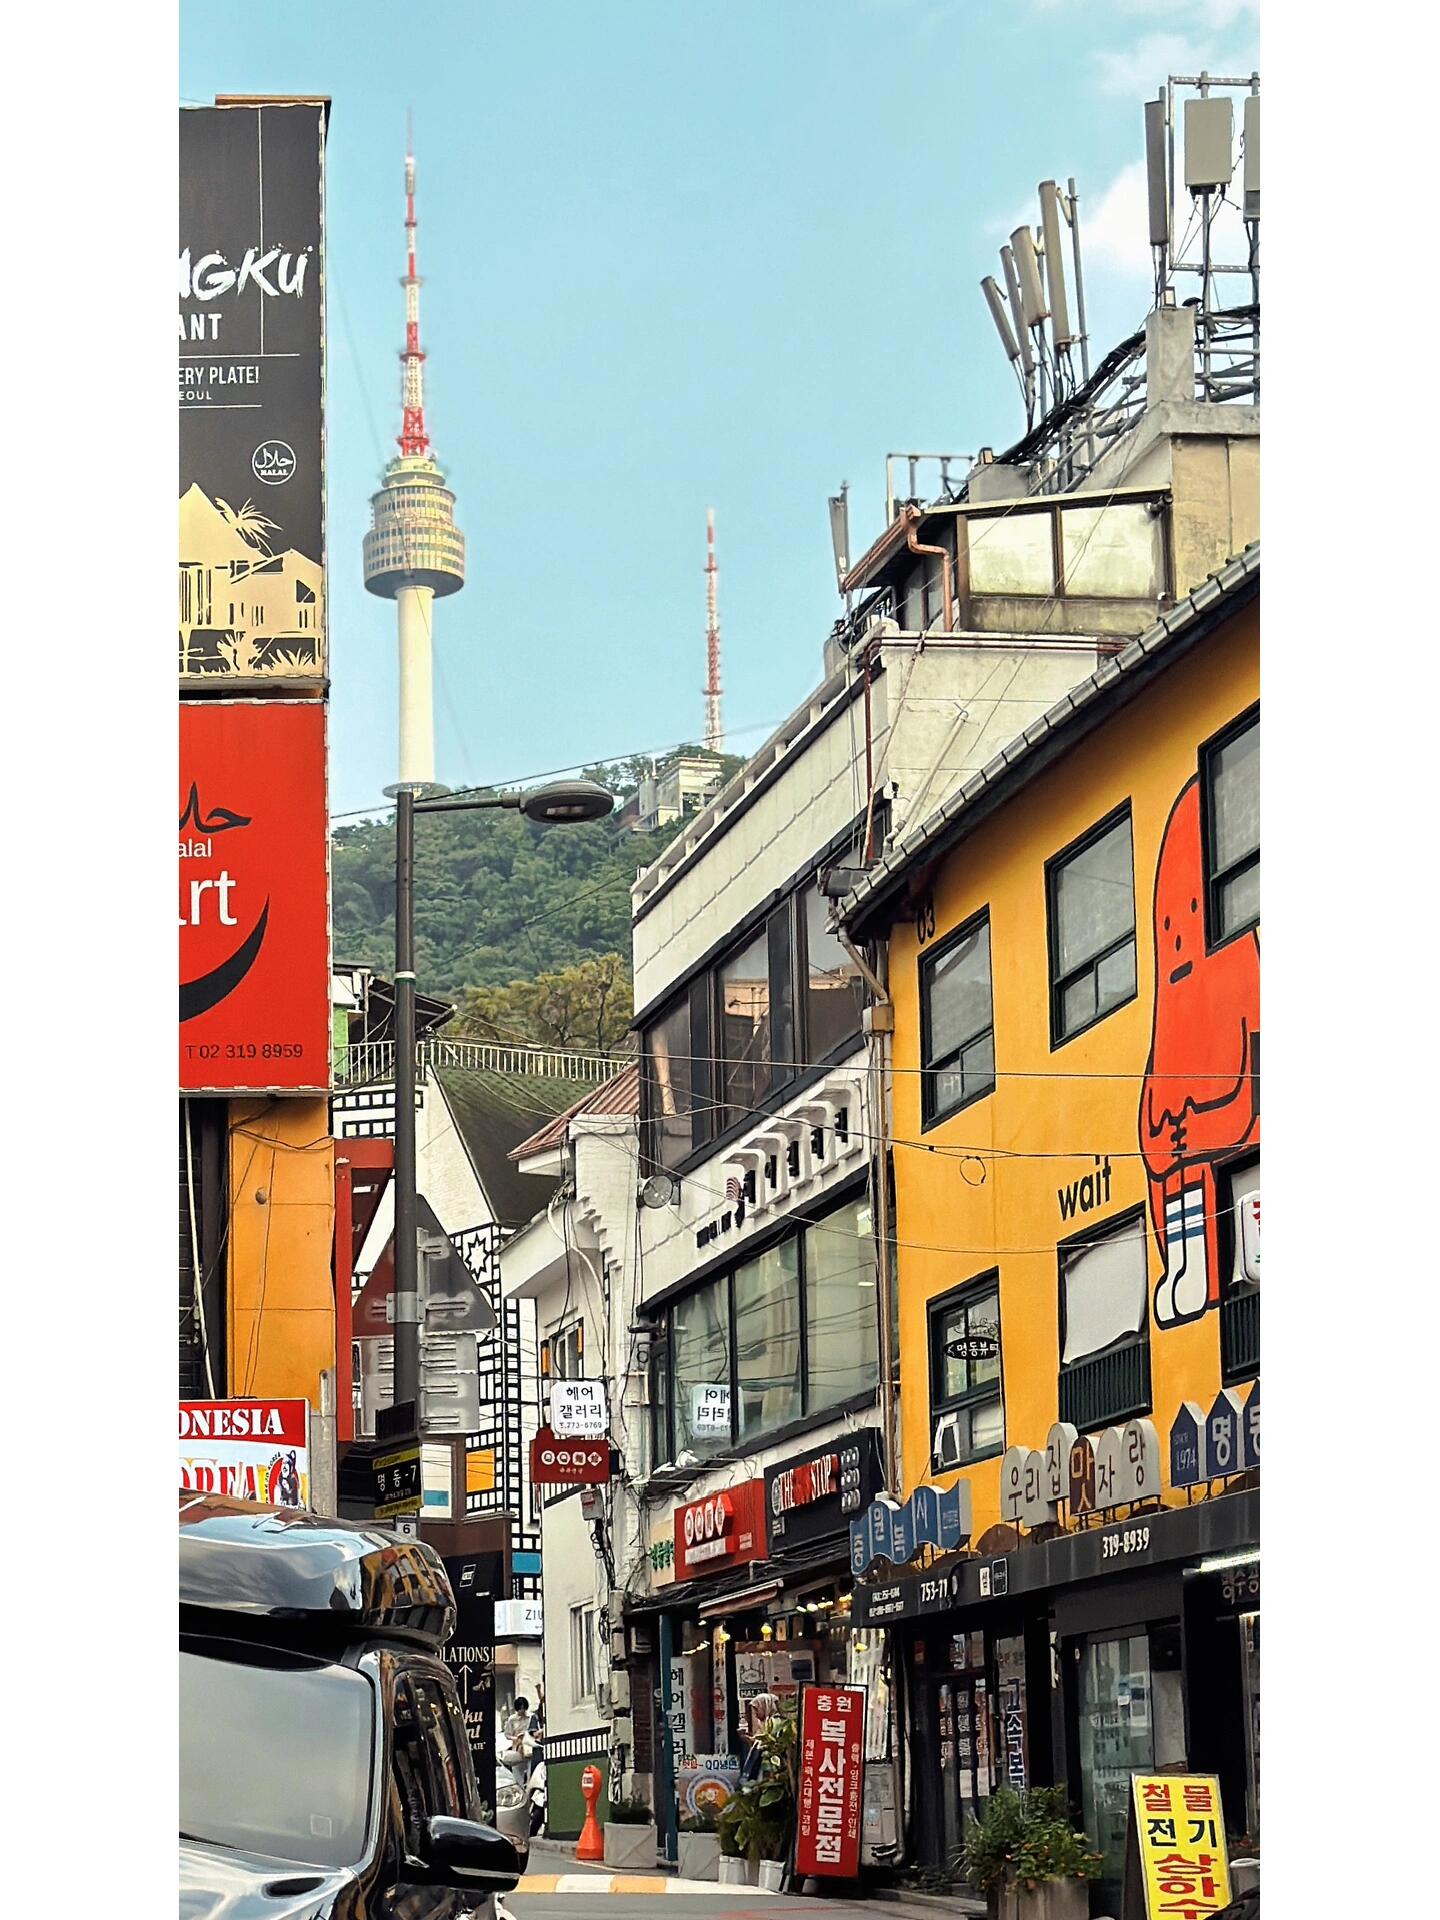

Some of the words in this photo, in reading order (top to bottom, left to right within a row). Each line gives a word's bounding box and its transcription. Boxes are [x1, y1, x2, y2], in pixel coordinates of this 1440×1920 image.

[209, 366, 259, 384] PLATE!
[179, 870, 237, 926] rt
[199, 1044, 220, 1059] 02
[225, 1044, 257, 1059] 319
[263, 1043, 303, 1058] 8959
[1057, 1155, 1112, 1220] wait
[566, 1386, 594, 1401] 헤어
[560, 1404, 602, 1419] 갤러리
[402, 1523, 411, 1535] 6
[1102, 1527, 1150, 1558] 319-8939
[815, 1718, 846, 1863] 복사전문점
[1142, 1783, 1212, 1813] 철물
[1147, 1818, 1218, 1849] 전기
